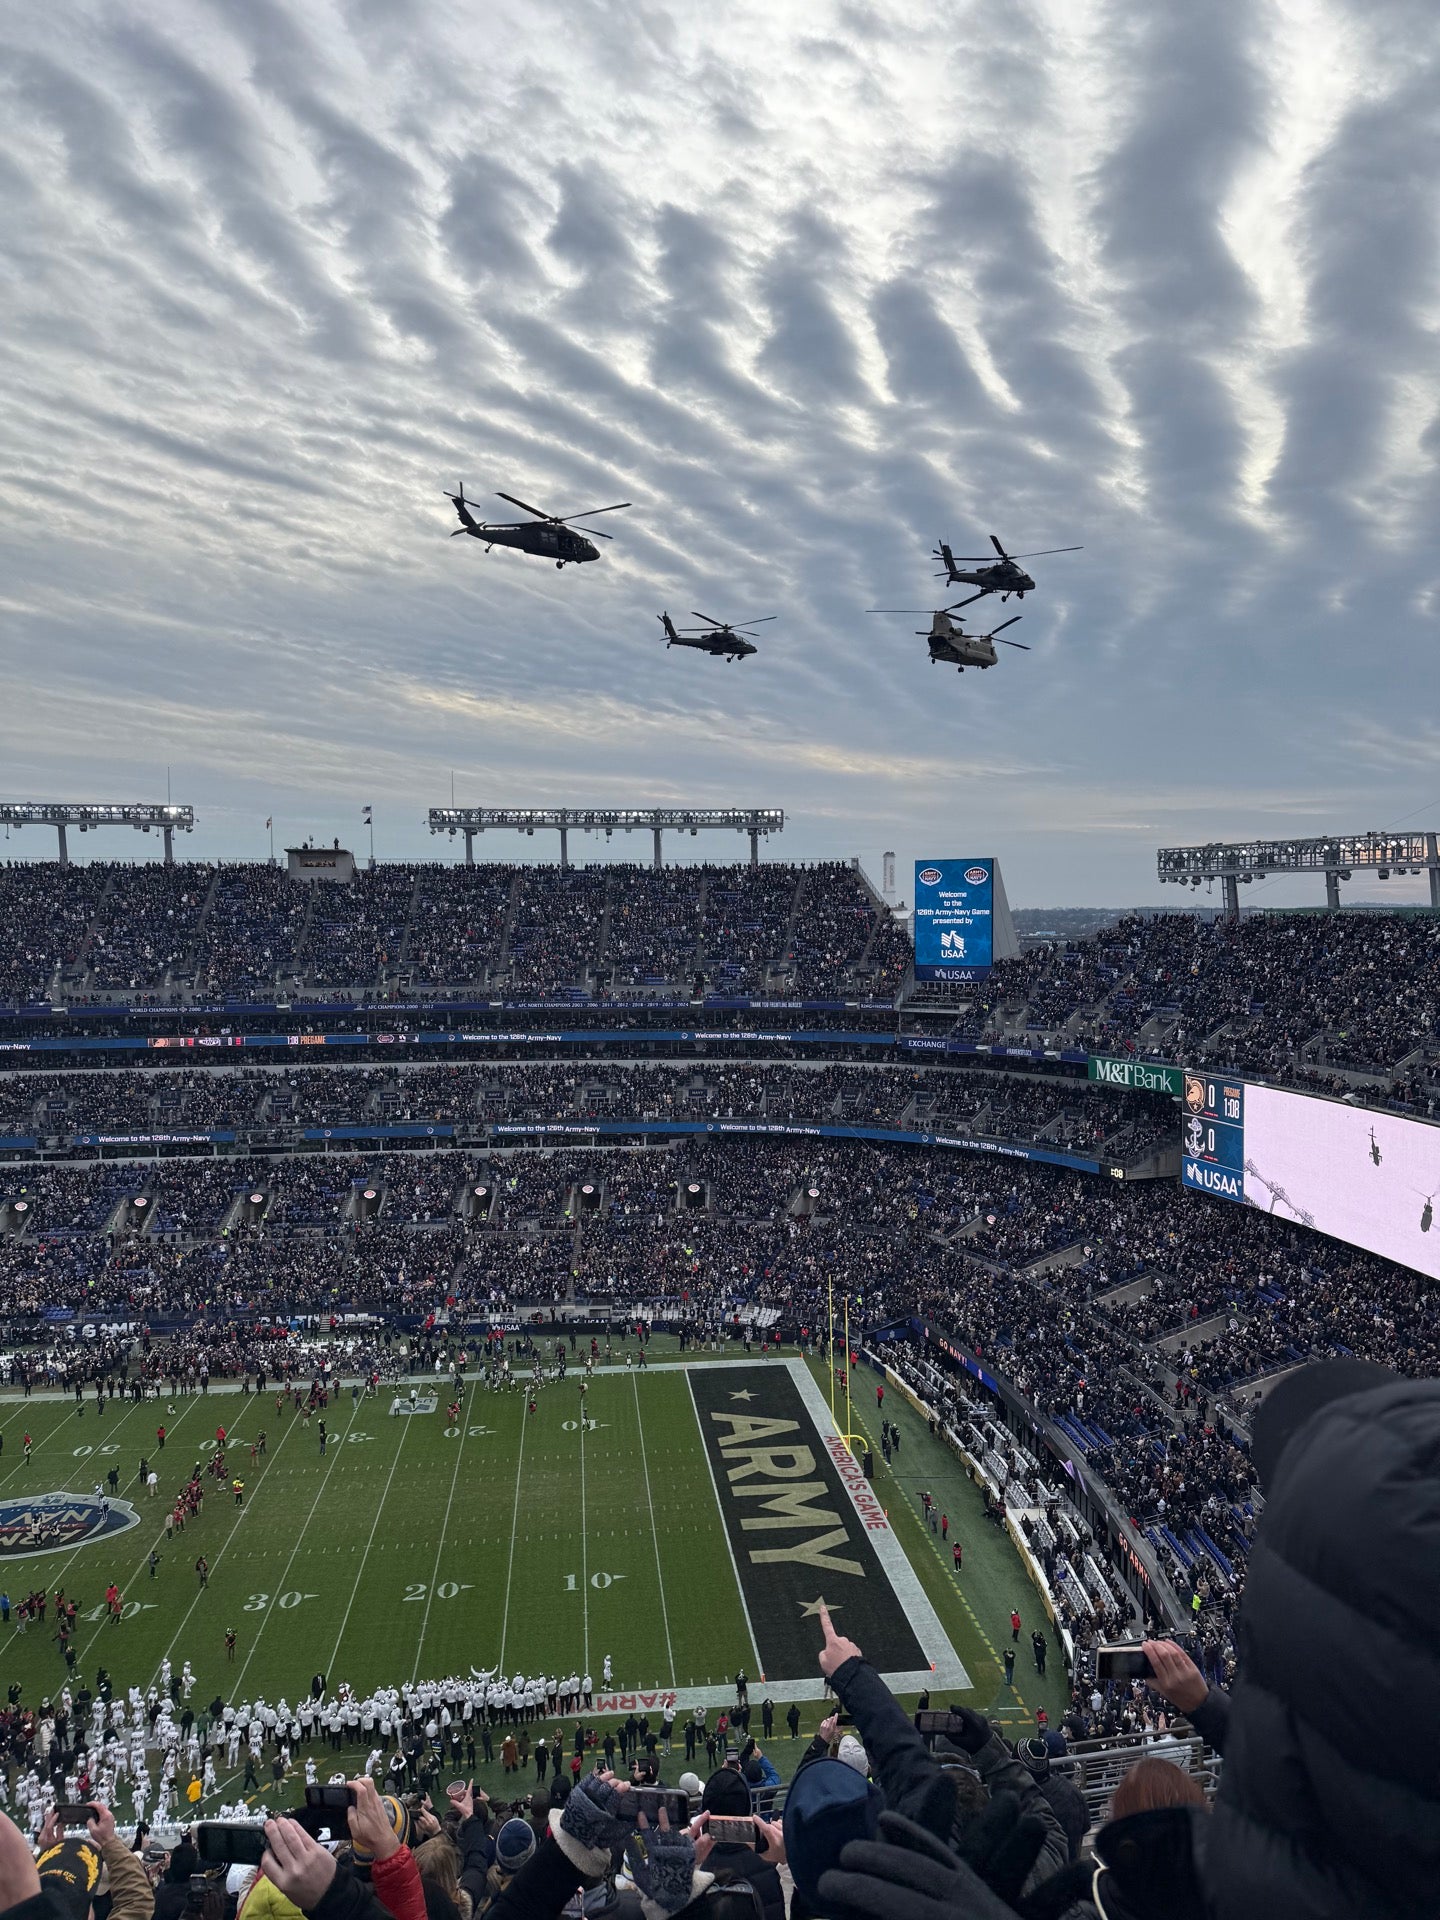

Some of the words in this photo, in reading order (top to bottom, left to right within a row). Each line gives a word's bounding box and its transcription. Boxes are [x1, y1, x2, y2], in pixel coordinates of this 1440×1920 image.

[941, 950, 964, 958] USAA
[948, 970, 973, 980] USAA
[300, 1035, 326, 1044] PREGAME
[908, 1040, 946, 1048] EXCHANGE
[1095, 1059, 1133, 1085] M&T
[1134, 1066, 1173, 1092] Bank
[1208, 1085, 1215, 1107] 0
[1224, 1086, 1241, 1099] PREGAME
[1224, 1098, 1240, 1119] 1:08
[786, 1127, 821, 1135] Army-Navy
[1208, 1129, 1215, 1151] 0
[935, 1136, 962, 1146] Welcome
[998, 1146, 1030, 1159] Army-Navy
[1204, 1169, 1239, 1197] USAA
[940, 1338, 948, 1350] GO
[949, 1345, 968, 1367] NAVY!
[443, 1426, 487, 1438] 20
[73, 1445, 121, 1456] 50
[823, 1436, 867, 1491] AMERICA'S
[854, 1494, 888, 1530] GAME
[710, 1412, 866, 1577] ARMY
[0, 1508, 93, 1526] NAV
[1119, 1532, 1128, 1552] GO
[1130, 1549, 1150, 1590] ARMY!
[402, 1582, 460, 1601] 20
[562, 1572, 612, 1592] 10
[243, 1591, 302, 1611] 30
[80, 1602, 141, 1621] 40
